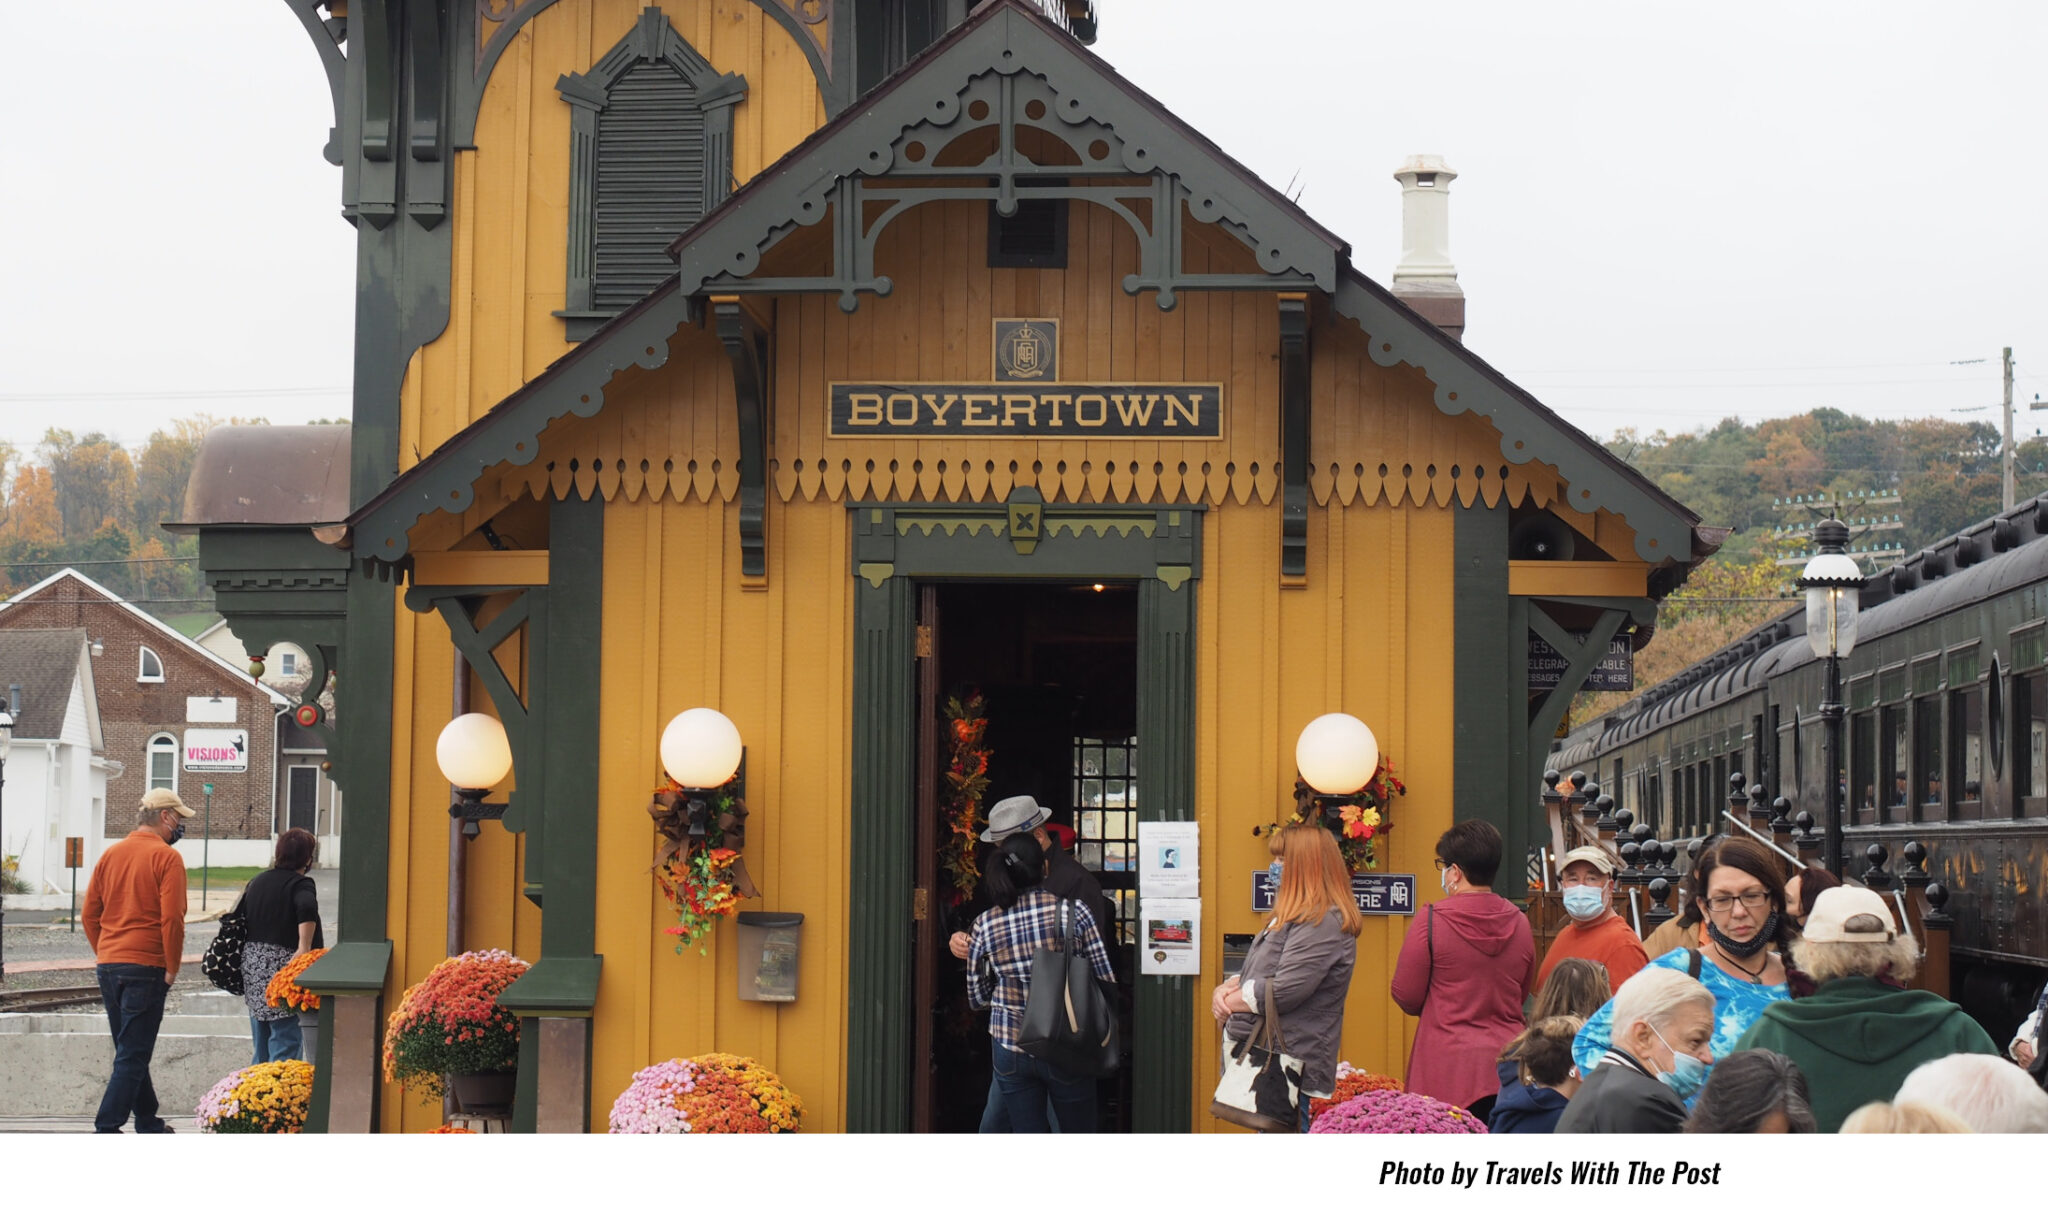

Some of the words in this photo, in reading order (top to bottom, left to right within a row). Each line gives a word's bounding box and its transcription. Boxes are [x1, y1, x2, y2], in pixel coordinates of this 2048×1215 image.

[848, 394, 1203, 427] BOYERTOWN
[1607, 674, 1628, 683] HERE
[188, 747, 237, 761] VISIONS
